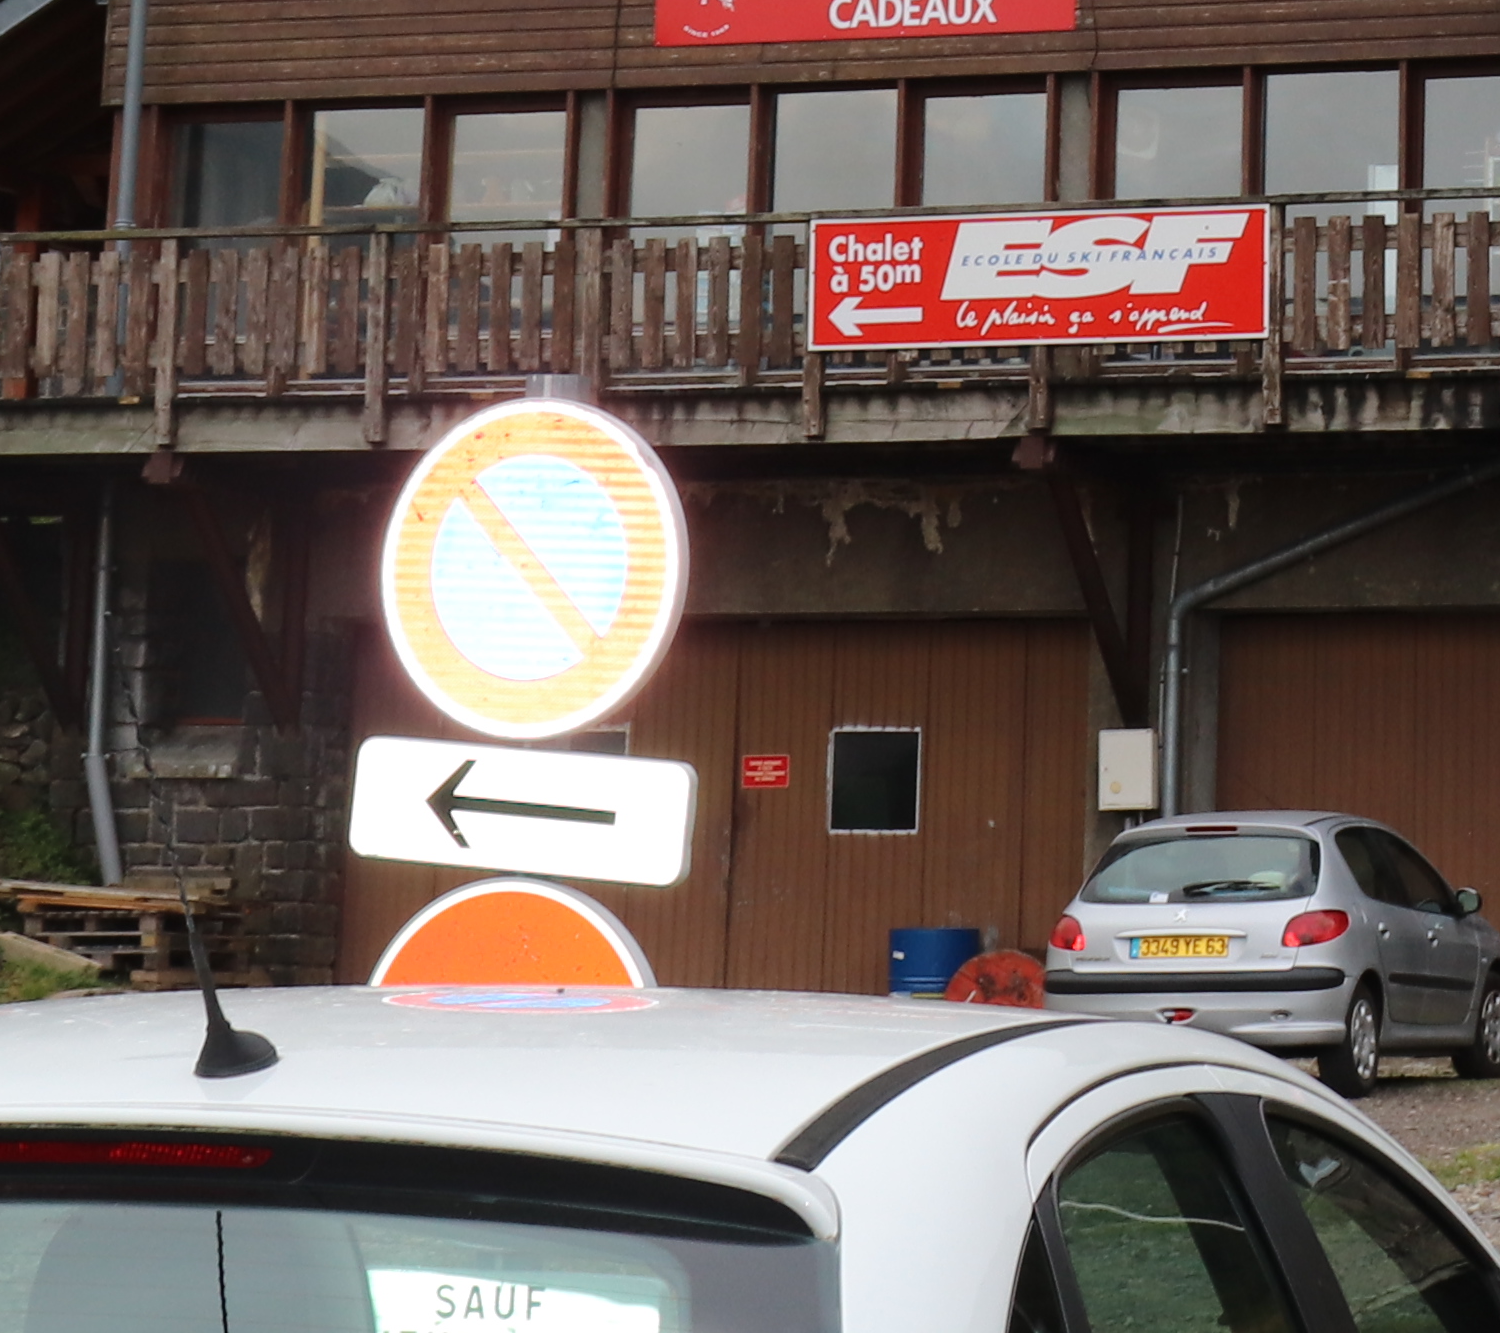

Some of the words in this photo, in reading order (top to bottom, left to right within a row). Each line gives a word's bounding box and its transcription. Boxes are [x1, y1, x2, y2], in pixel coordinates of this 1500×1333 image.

[828, 232, 924, 263] Chalet
[939, 213, 1250, 300] ESF
[961, 253, 1024, 267] ECOLE
[1032, 252, 1059, 265] DU
[1066, 251, 1102, 264] SKI
[830, 265, 849, 293] à
[859, 263, 922, 292] 50m
[1068, 310, 1095, 334] ça
[1141, 938, 1180, 956] 3349
[1184, 937, 1203, 955] YE
[1206, 937, 1226, 955] 63
[435, 1284, 546, 1321] SAUF
